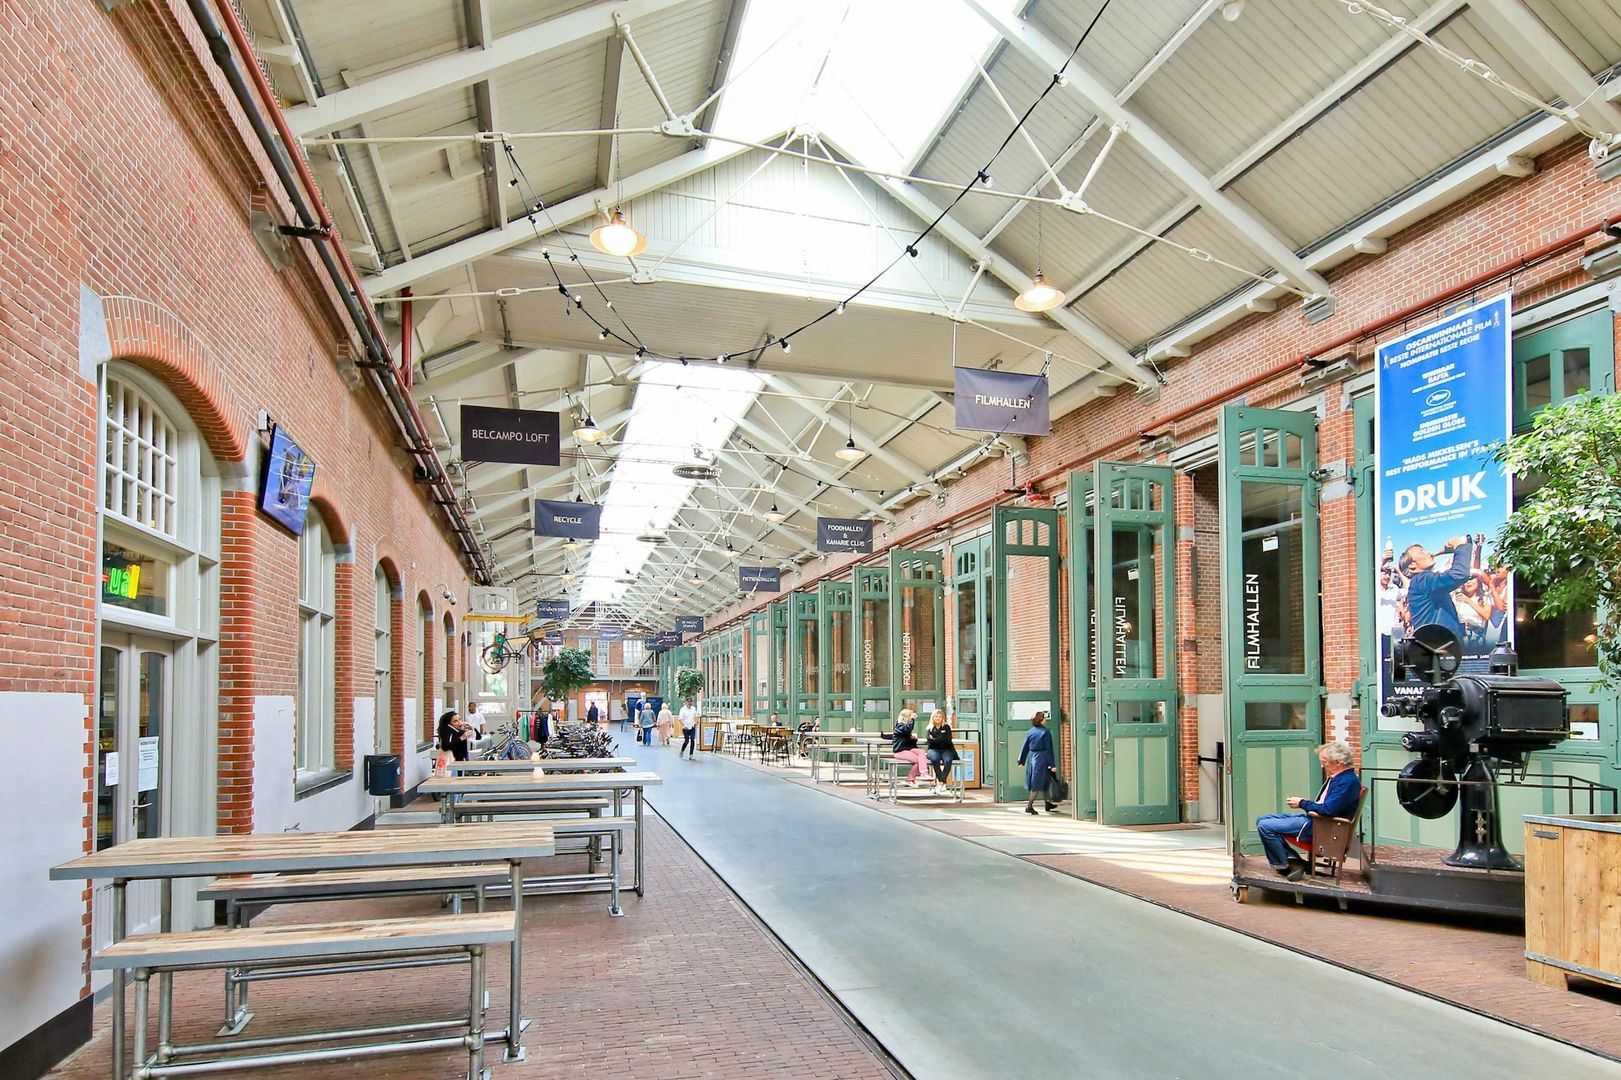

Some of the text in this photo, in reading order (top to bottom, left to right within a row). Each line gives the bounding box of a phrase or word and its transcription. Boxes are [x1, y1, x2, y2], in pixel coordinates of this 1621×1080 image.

[1389, 320, 1492, 365] BESTE INTERNATIONALE FILM
[1405, 319, 1473, 351] OSCARWINNAAR
[1400, 333, 1481, 369] NOMINATIE BESTE REGIE
[1422, 363, 1455, 379] WINNAAR
[1427, 371, 1449, 384] BAFTA
[975, 394, 1031, 409] FILMHALLEN
[472, 429, 550, 443] BELCAMPO LOFT
[1413, 424, 1441, 437] GOLDEN
[1442, 416, 1466, 429] GLOBE
[1427, 439, 1480, 459] MIKKELSEN'S
[1385, 467, 1401, 477] BEST
[1402, 452, 1457, 473] PERFORMANCE
[1458, 449, 1468, 459] IN
[1394, 470, 1488, 516] DRUK
[553, 515, 582, 524] RECYCLE
[827, 524, 864, 532] FOODHALLEN
[1245, 573, 1261, 669] FILMHALLEN
[903, 632, 911, 686] FOODHALLEN
